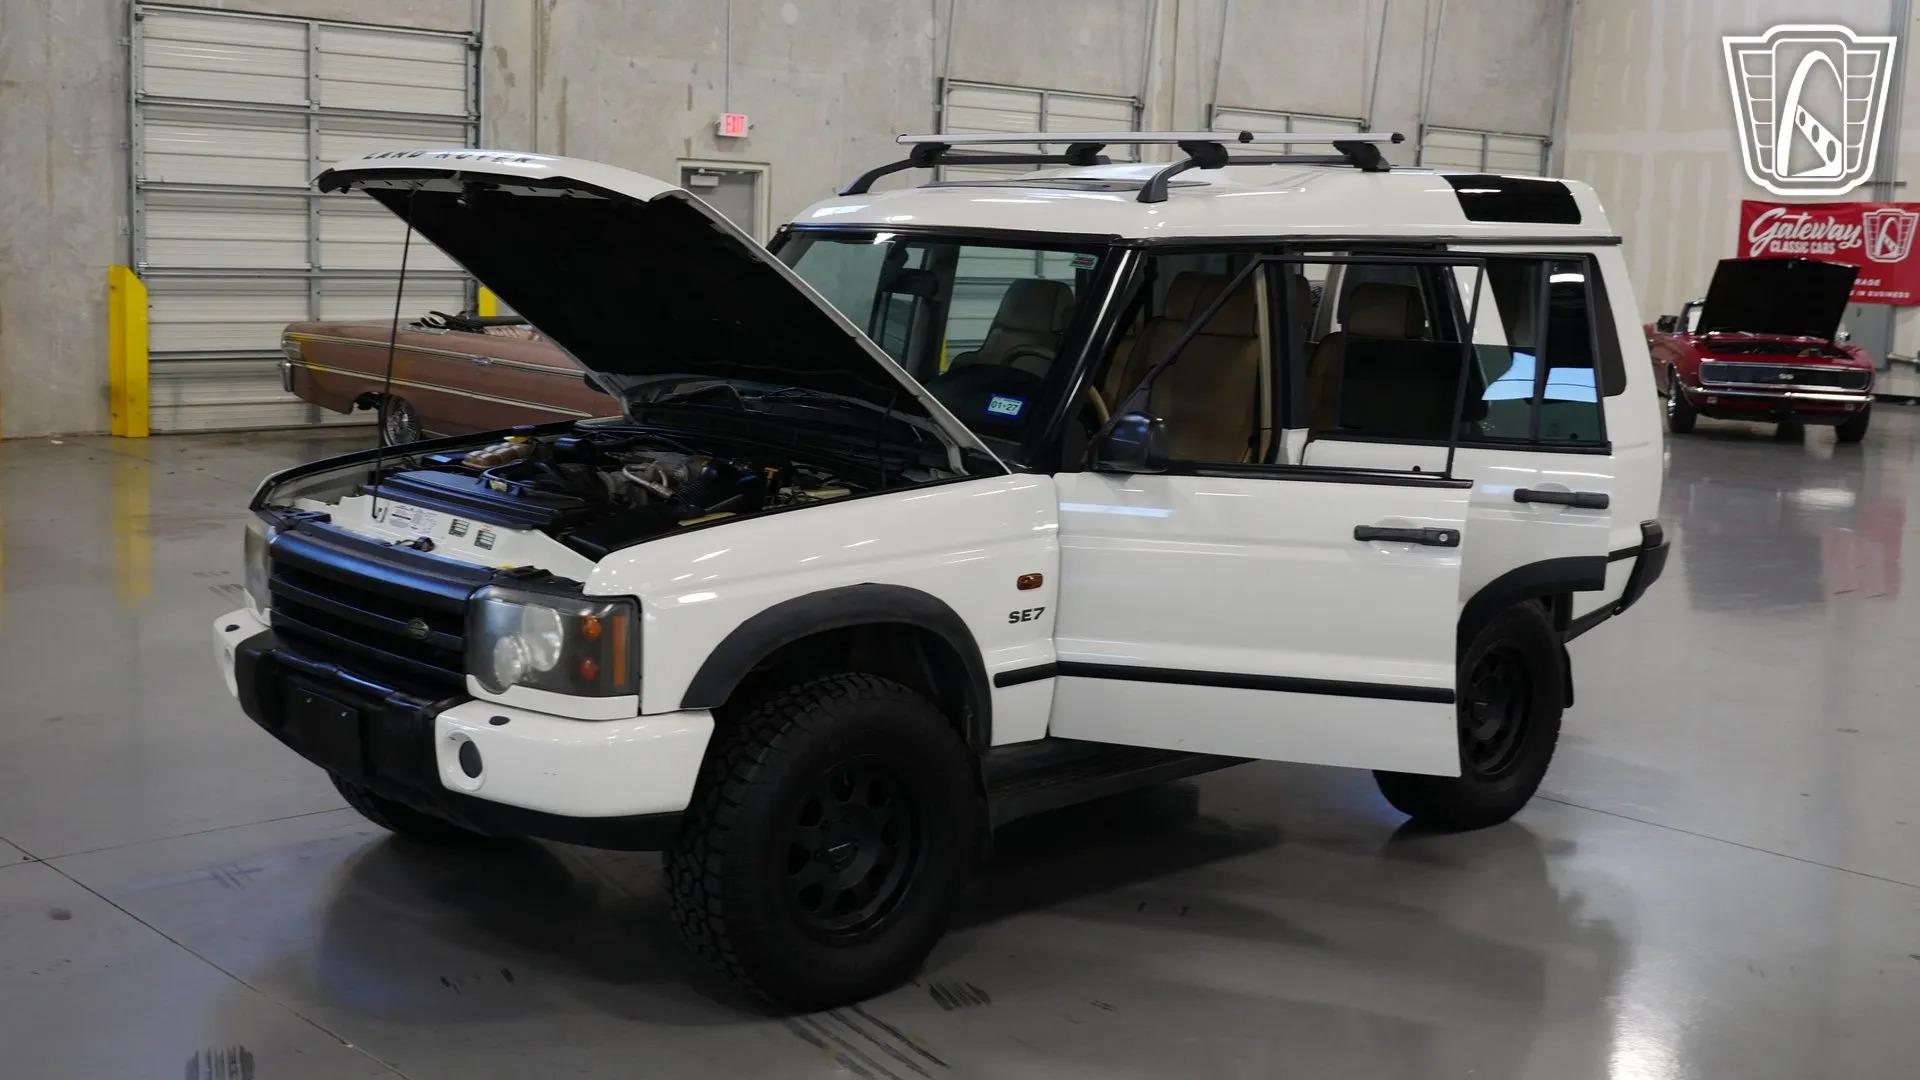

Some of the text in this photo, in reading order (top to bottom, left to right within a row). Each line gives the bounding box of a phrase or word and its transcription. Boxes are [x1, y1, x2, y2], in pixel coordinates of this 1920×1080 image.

[1748, 207, 1862, 258] Gateway
[1770, 240, 1836, 254] CLASSIC CARS
[1854, 278, 1881, 286] RADE
[1008, 606, 1045, 624] SE7
